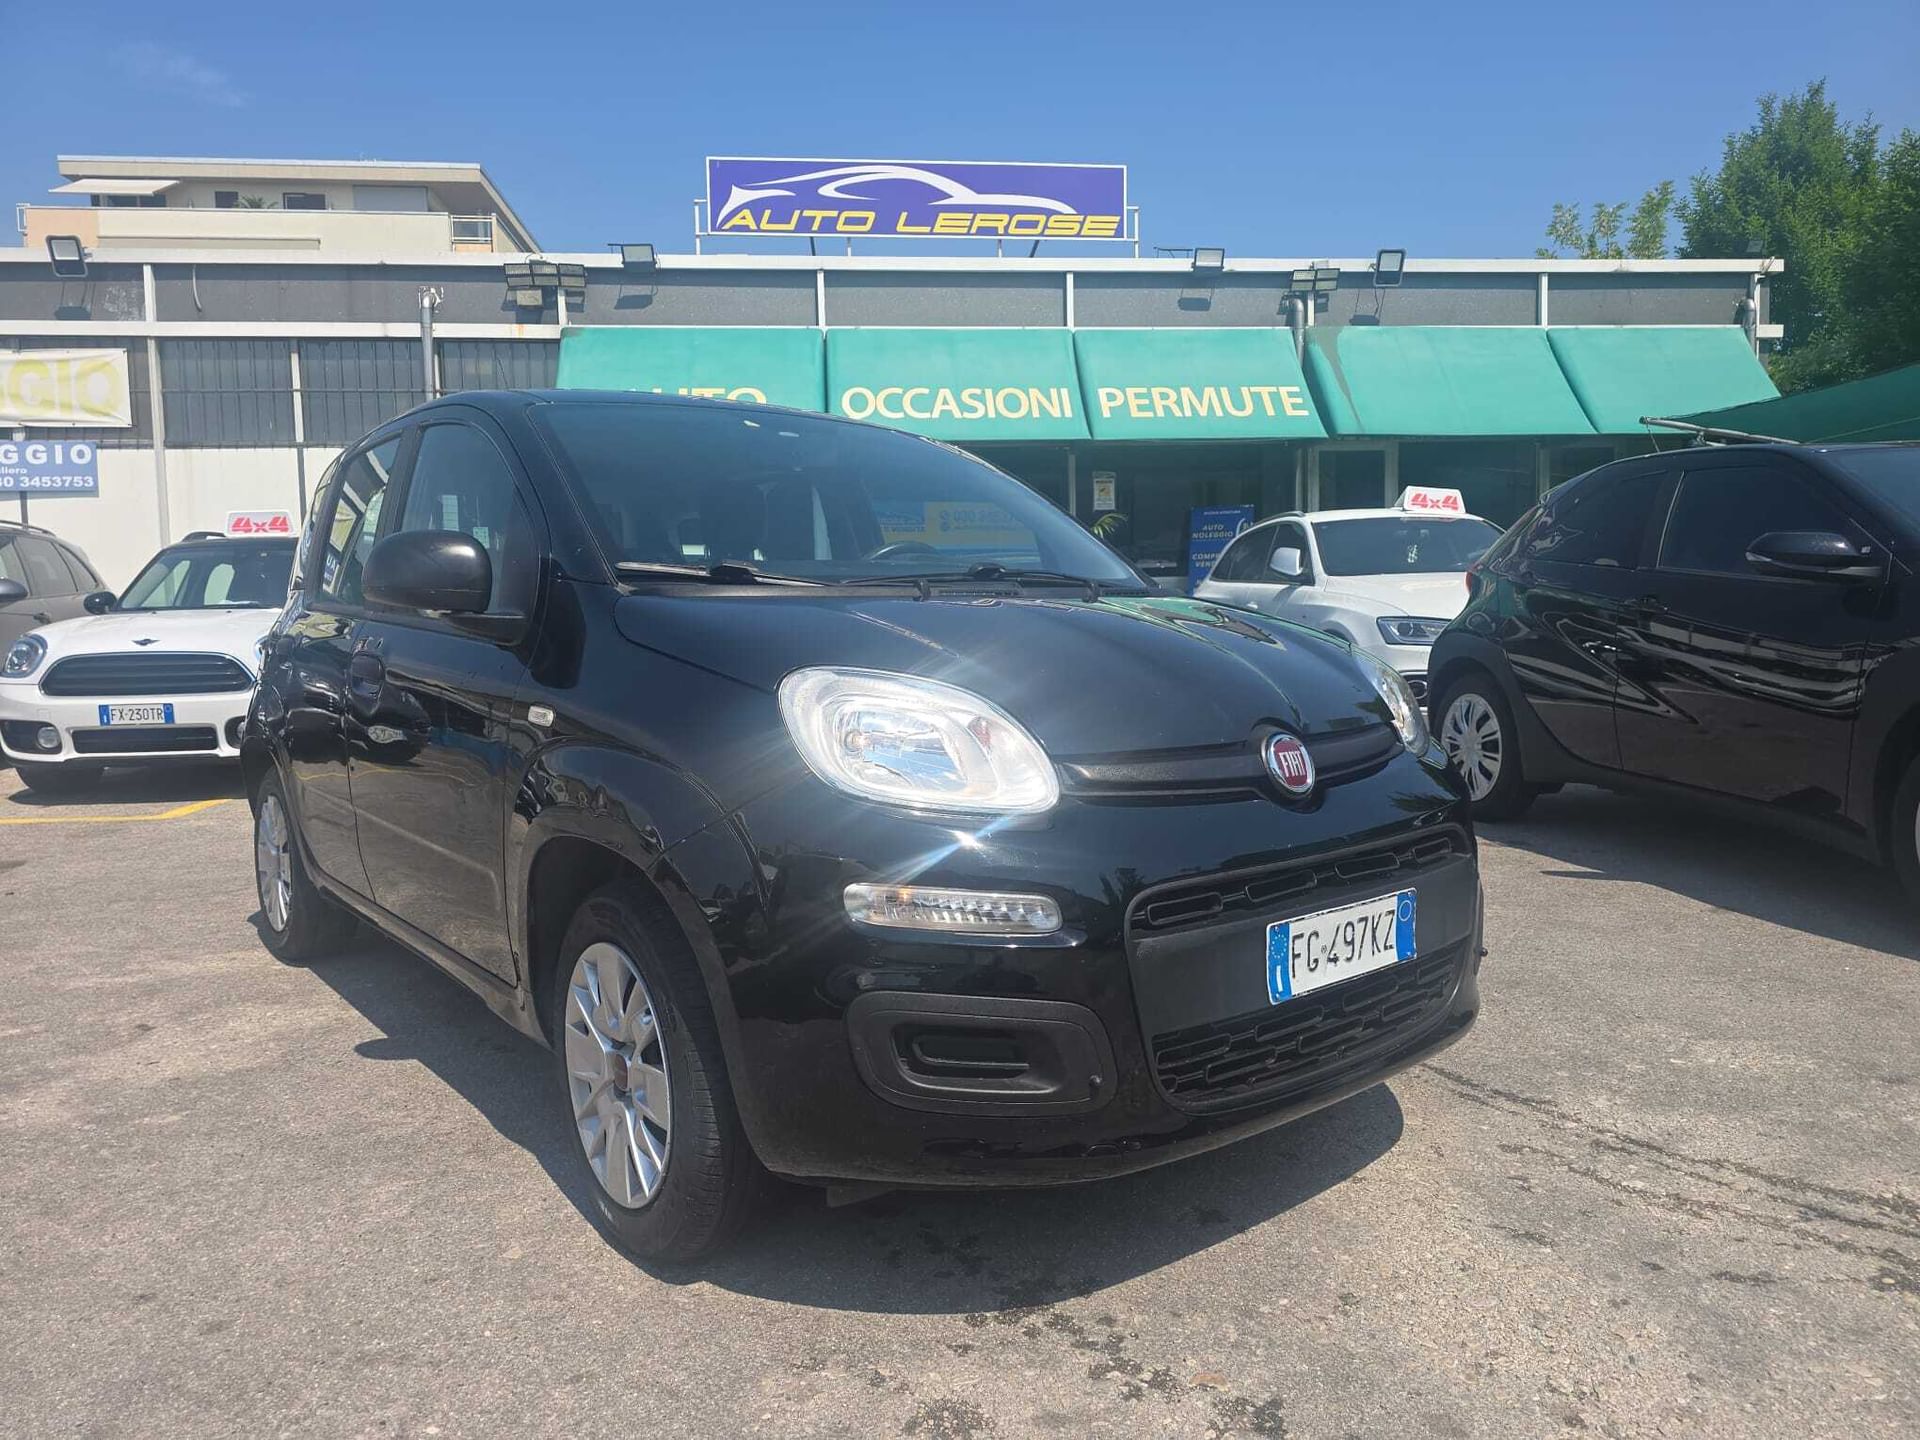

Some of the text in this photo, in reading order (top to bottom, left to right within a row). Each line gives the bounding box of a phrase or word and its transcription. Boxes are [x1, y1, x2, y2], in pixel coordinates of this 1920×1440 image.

[721, 209, 1122, 236] AUTO LEROSE
[0, 359, 119, 416] GIO
[841, 387, 1072, 419] OCCASIONI
[1101, 386, 1309, 417] PERMUTE
[20, 476, 94, 487] 3453753
[1411, 493, 1459, 510] 4x4
[231, 516, 289, 533] 4x4
[1192, 531, 1233, 539] NOLEGGIO
[1278, 750, 1306, 778] FIAT
